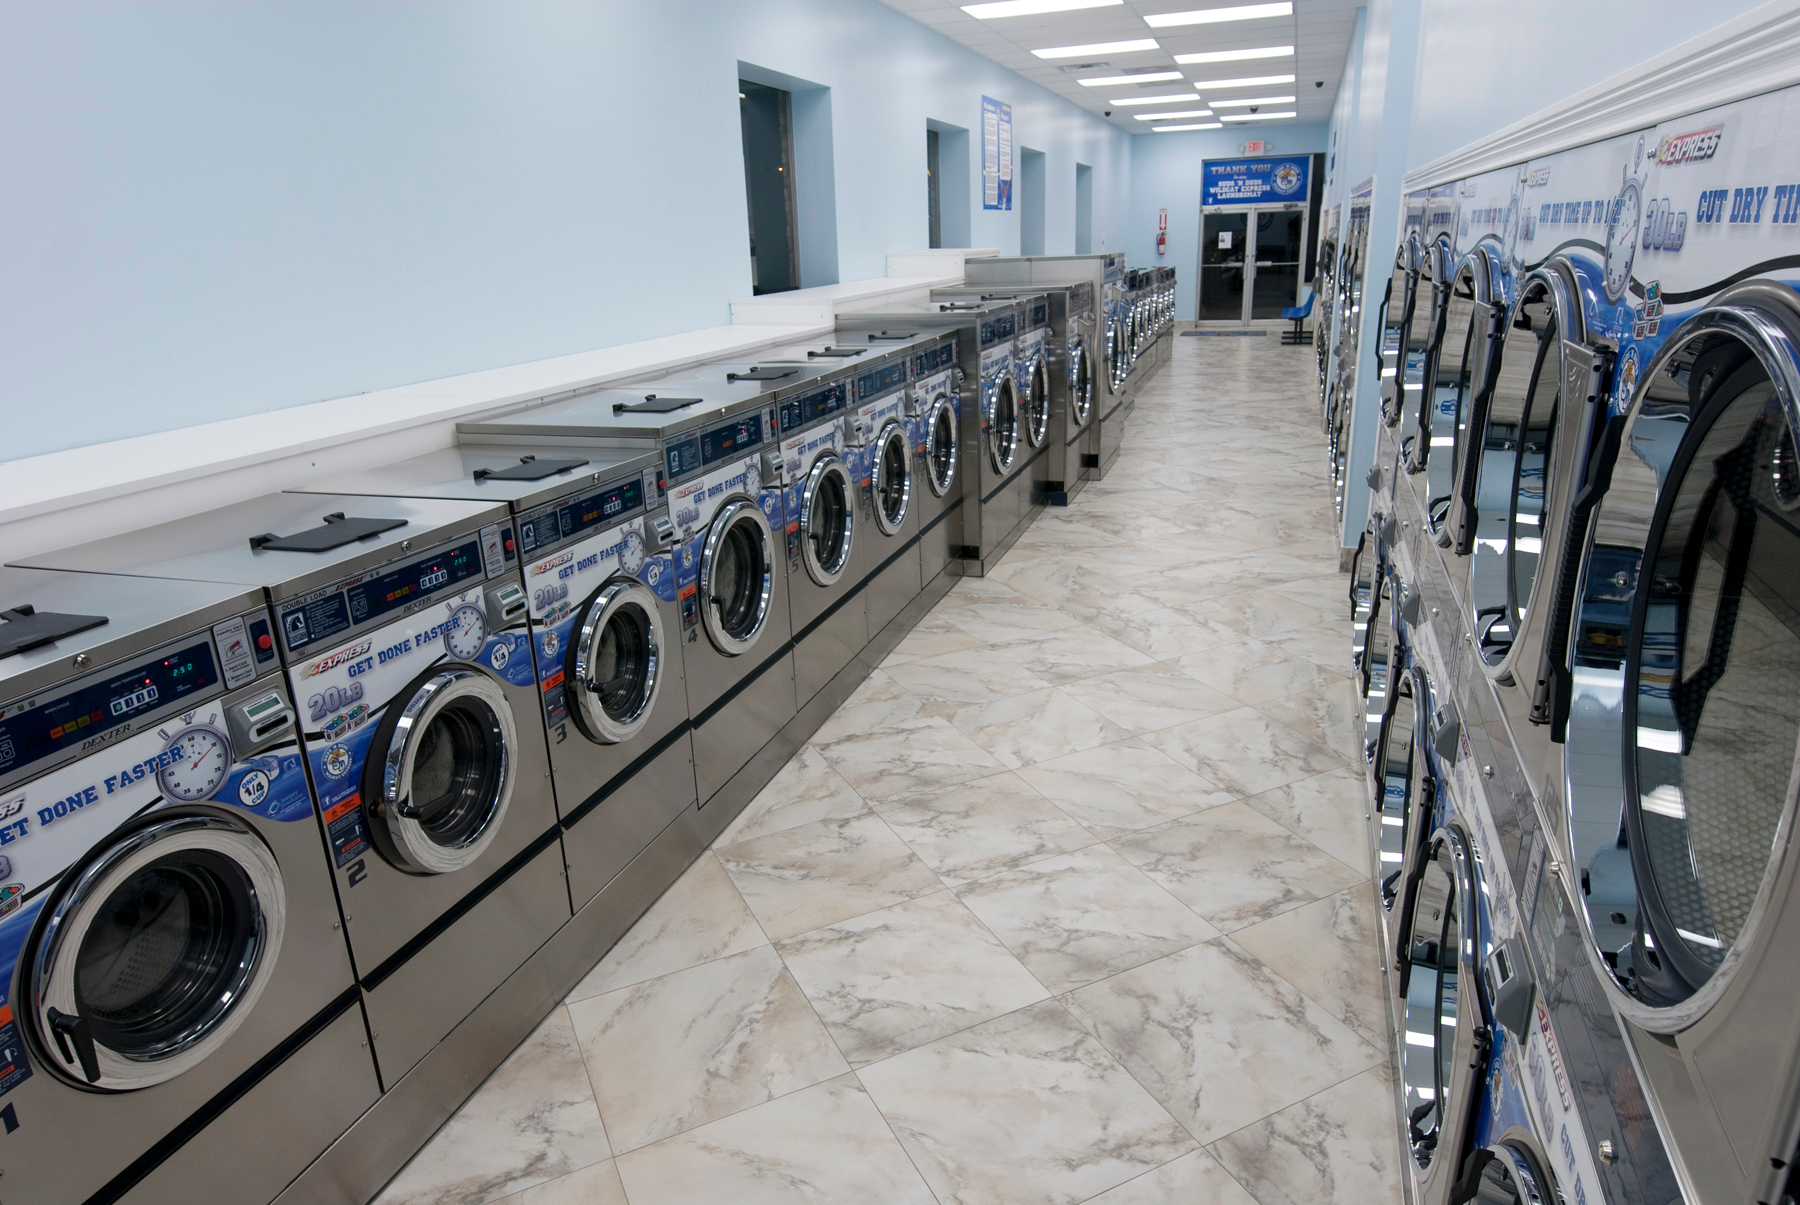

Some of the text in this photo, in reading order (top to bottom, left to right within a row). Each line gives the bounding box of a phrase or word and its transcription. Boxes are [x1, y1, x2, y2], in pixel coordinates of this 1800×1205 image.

[1248, 141, 1262, 152] EXIT
[1667, 131, 1721, 165] EXPRESS
[1211, 164, 1271, 175] THANK YOU
[1217, 191, 1262, 199] LAUNDROMAT
[1696, 189, 1729, 223] CUT
[1729, 186, 1769, 223] DRY
[1539, 203, 1551, 223] CUT
[1551, 203, 1564, 223] DRY
[1564, 201, 1581, 223] TIME
[1581, 200, 1592, 223] UP
[1593, 200, 1604, 223] TO
[1642, 198, 1687, 252] 30LB
[798, 431, 834, 455] GET DONE FASTER
[694, 472, 746, 504] GET DONE FASTER
[676, 507, 699, 527] 30LB
[541, 552, 573, 574] EXPRESS
[558, 539, 629, 579] GET DONE FASTER
[792, 559, 799, 573] 5
[282, 576, 364, 612] DOUBLE LOAD EXPRESS
[403, 596, 432, 613] DEXTER
[534, 583, 568, 611] 20LB
[347, 617, 460, 678] GET DONE FASTER
[688, 627, 698, 643] 4
[318, 641, 372, 673] EXPRESS
[122, 671, 147, 683] TEMPERATURE
[307, 681, 364, 722] 20LB
[81, 723, 131, 751] DEXTER
[554, 722, 567, 745] 3
[241, 772, 259, 789] ONLY
[244, 781, 265, 797] 1/4
[0, 817, 29, 846] ET
[37, 785, 99, 827] DONE
[103, 746, 184, 795] FASTER
[251, 790, 266, 804] CUP
[346, 858, 367, 888] 2
[1541, 1019, 1571, 1112] EXPRESS
[1560, 1123, 1588, 1205] CUT DR
